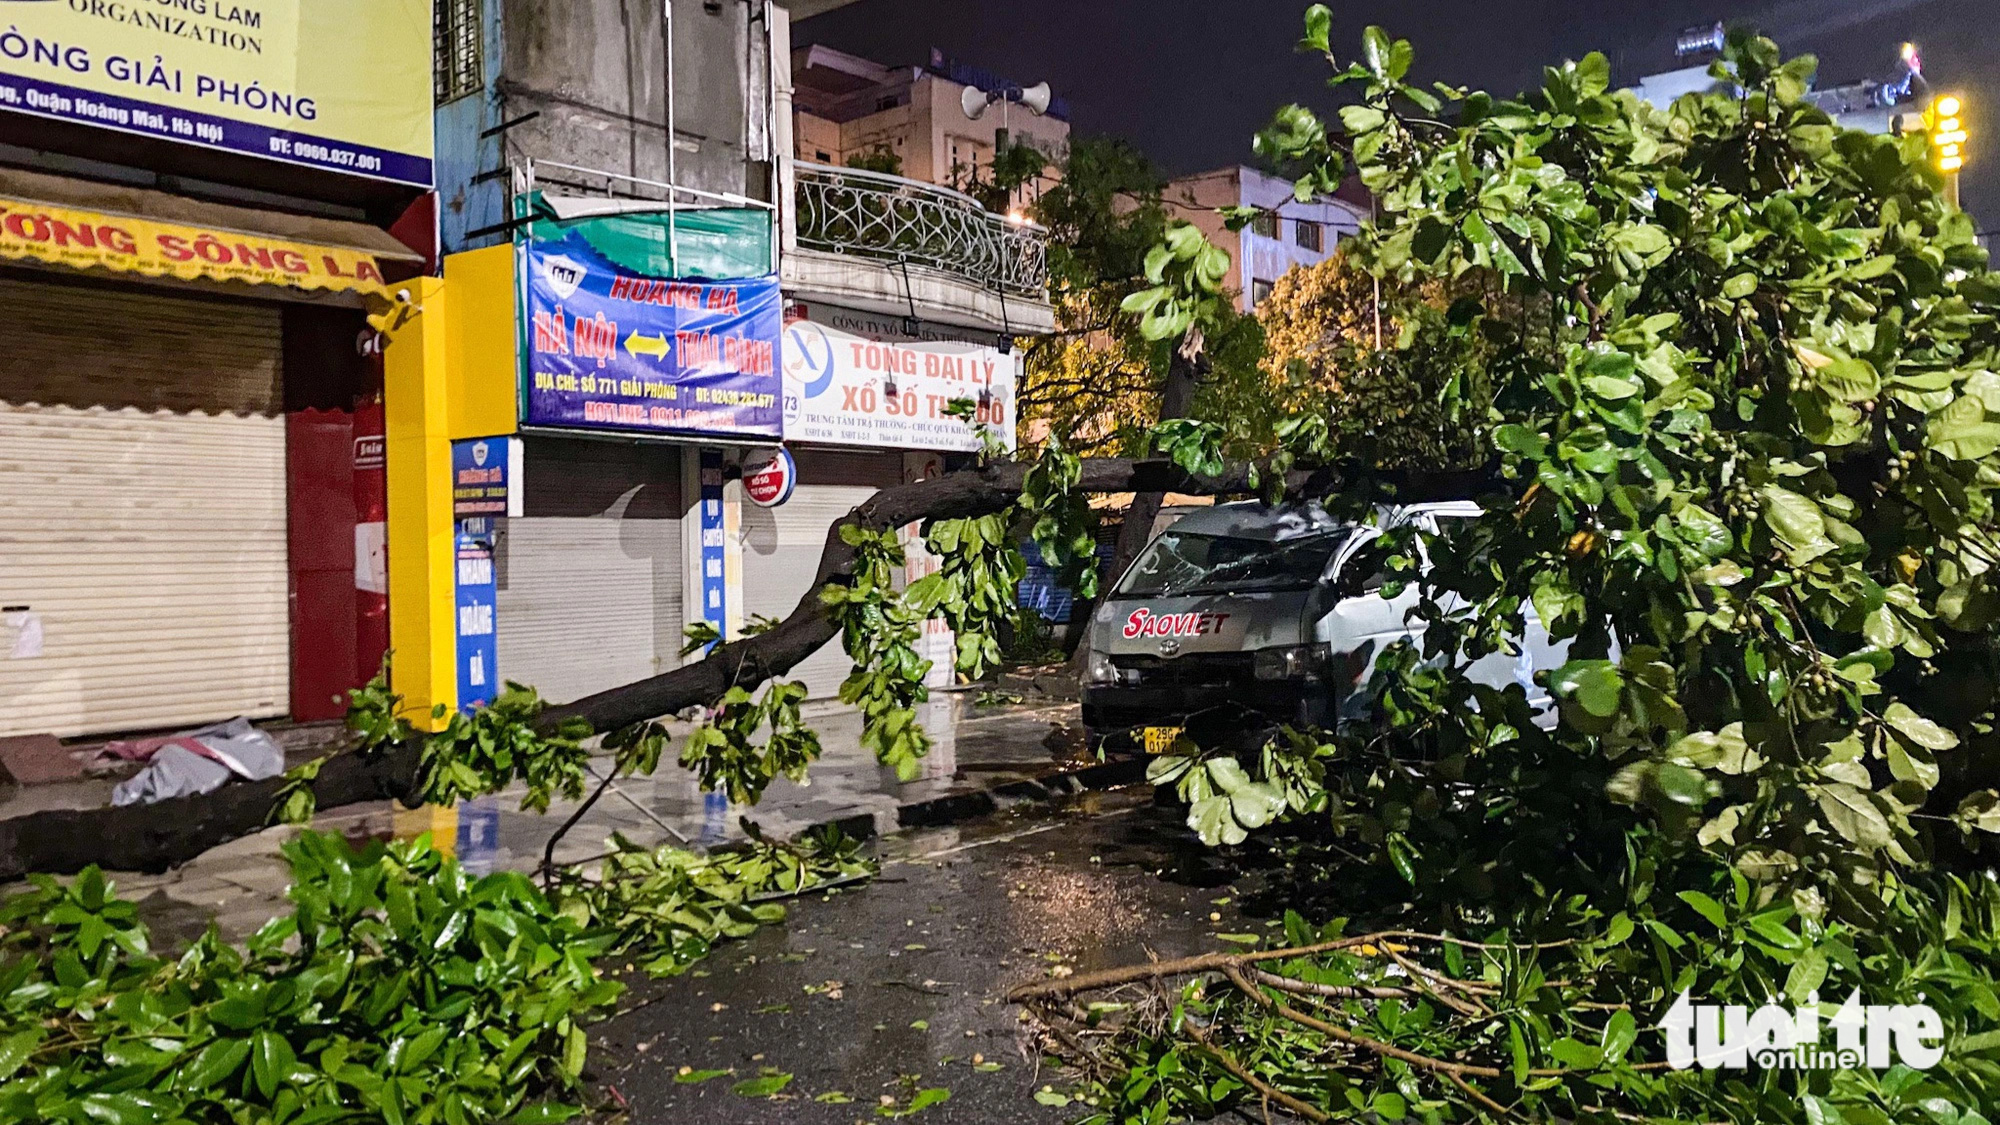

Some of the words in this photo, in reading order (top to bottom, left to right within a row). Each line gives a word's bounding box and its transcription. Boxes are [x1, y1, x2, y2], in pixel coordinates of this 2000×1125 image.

[68, 0, 262, 54] ORGANIZATION
[215, 2, 261, 28] LAM
[105, 55, 181, 93] GIẢI
[196, 74, 317, 120] PHÓNG
[26, 88, 72, 113] Quận
[75, 97, 129, 124] Hoàng
[132, 109, 169, 132] Mai,
[172, 117, 193, 135] Hà
[196, 122, 223, 143] Nội
[157, 233, 309, 274] SÔNG
[322, 255, 385, 286] LA
[534, 304, 569, 355] HÀ
[574, 311, 618, 368] NỘI
[675, 326, 720, 371] THÁI
[724, 330, 773, 377] BÌNH
[866, 321, 880, 333] TY
[598, 378, 618, 394] 771
[850, 336, 917, 375] TỔNG
[925, 353, 963, 386] ĐẠI
[971, 357, 995, 385] LÝ
[806, 413, 835, 424] TRUNG
[842, 378, 878, 413] XỔ
